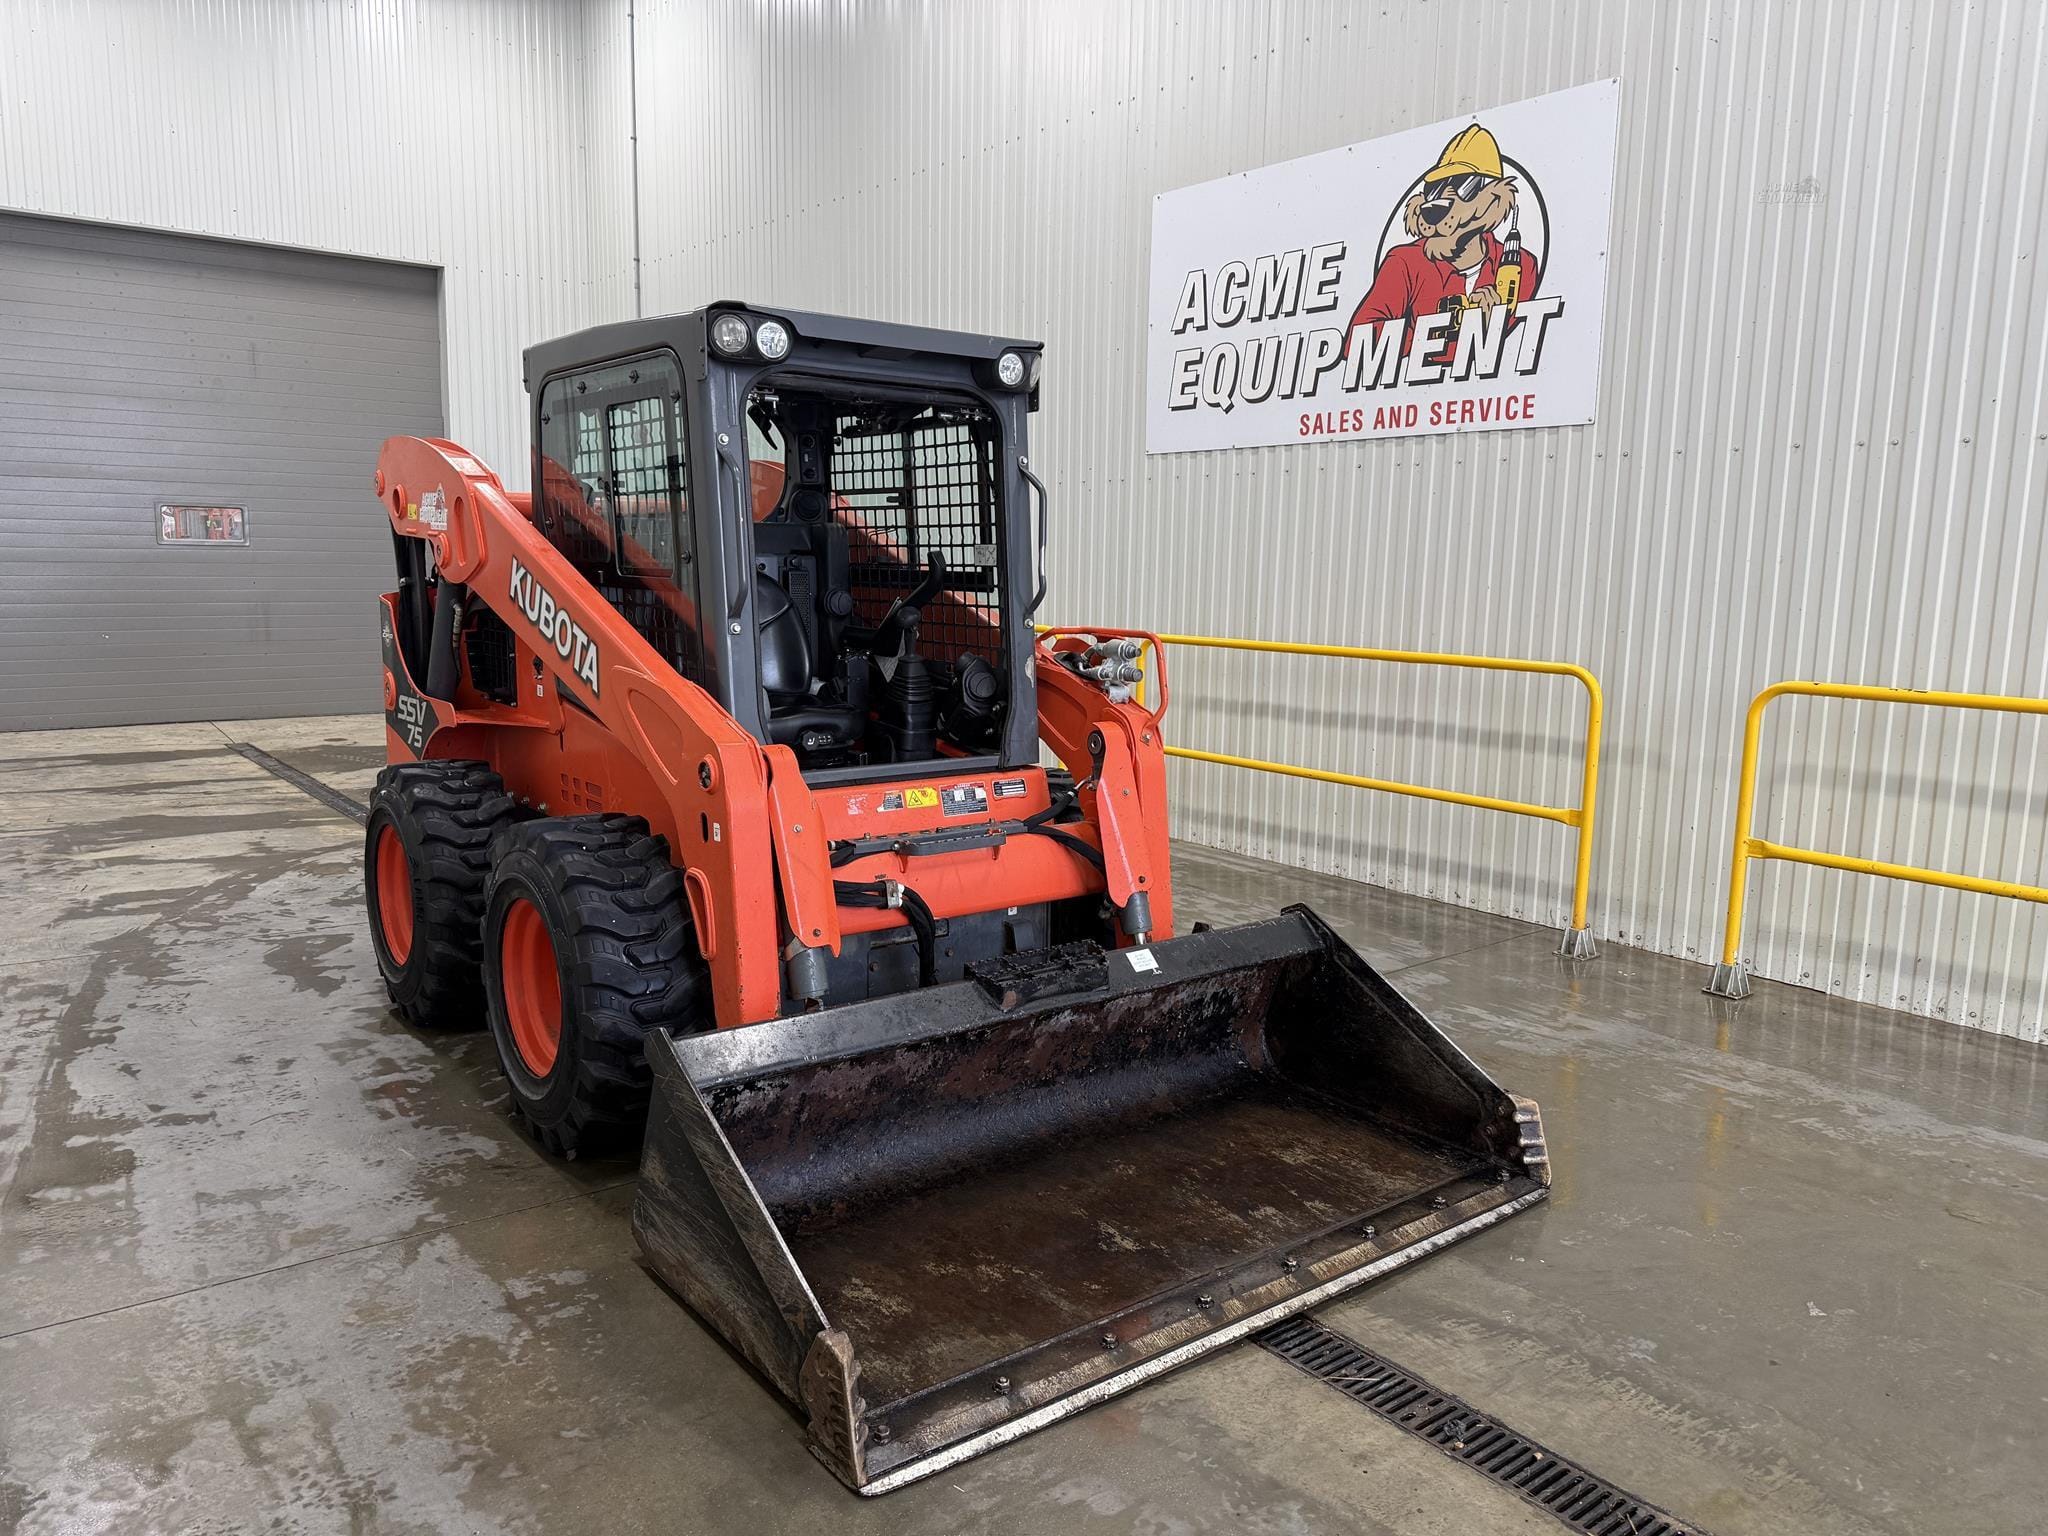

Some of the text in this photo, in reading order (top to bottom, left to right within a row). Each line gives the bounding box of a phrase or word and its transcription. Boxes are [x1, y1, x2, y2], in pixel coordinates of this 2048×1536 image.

[1171, 241, 1347, 335] ACME
[1168, 296, 1565, 413] EQUIPMENT
[1300, 394, 1536, 436] SALES AND SERVICE
[509, 556, 599, 694] KUBOTA
[397, 694, 426, 725] SSV
[407, 723, 422, 748] 75
